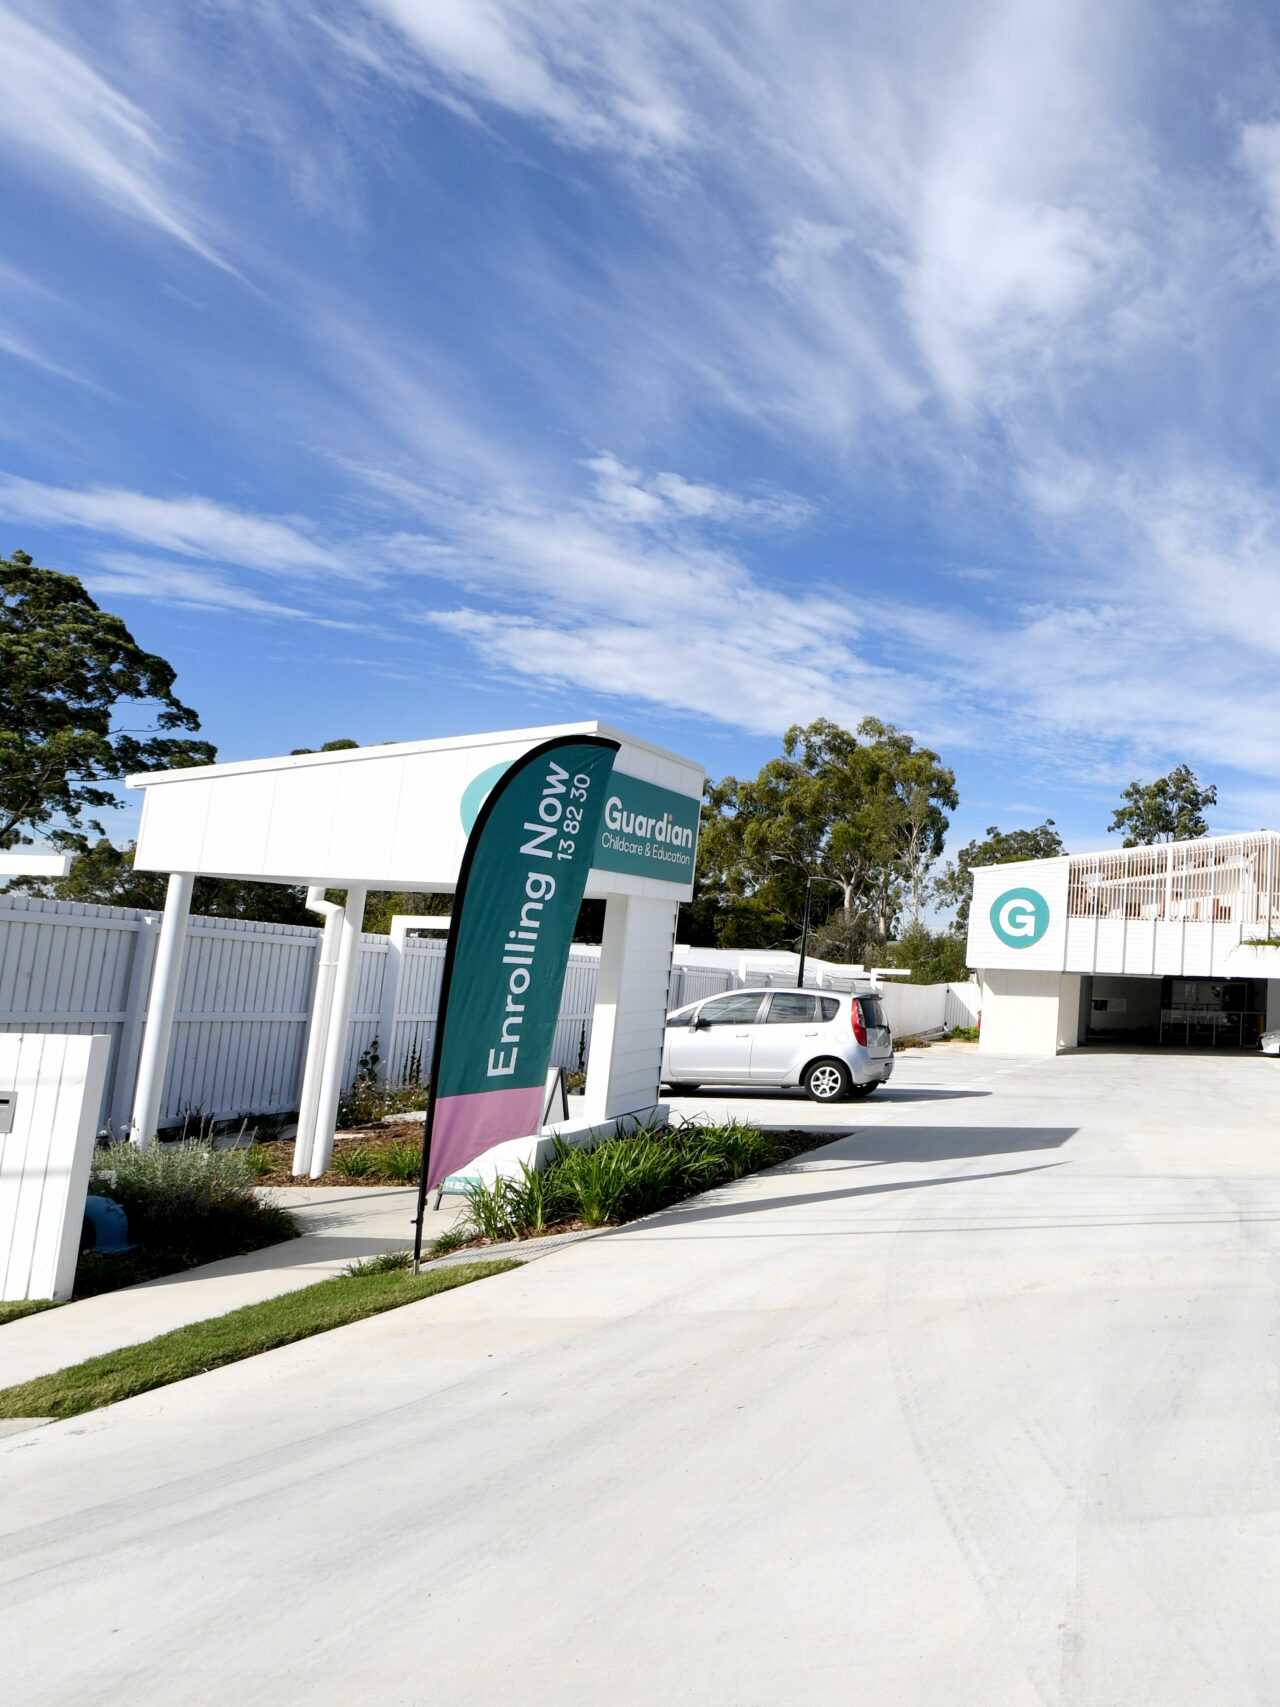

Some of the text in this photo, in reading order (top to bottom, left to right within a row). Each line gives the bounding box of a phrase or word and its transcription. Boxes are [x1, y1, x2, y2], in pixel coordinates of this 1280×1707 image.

[557, 773, 591, 861] 13 82 30
[605, 796, 693, 849] Guardian
[601, 832, 691, 865] Childcare & Education
[487, 761, 570, 1077] Enrolling Now
[999, 898, 1036, 937] G
